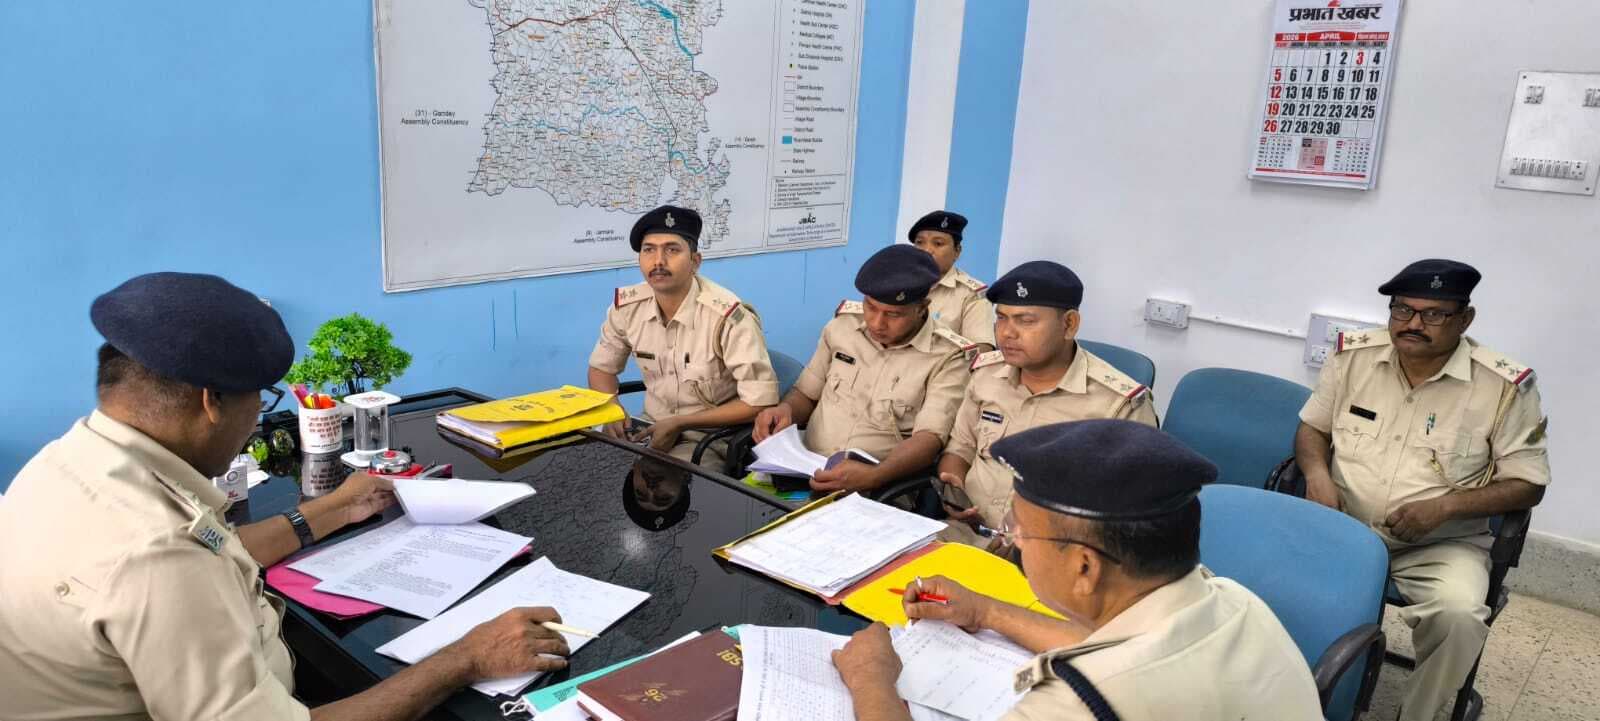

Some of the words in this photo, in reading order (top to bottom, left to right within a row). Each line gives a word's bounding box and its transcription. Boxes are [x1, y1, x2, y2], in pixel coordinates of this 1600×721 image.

[1289, 7, 1333, 21] प्रभात
[1337, 6, 1382, 20] खबर
[1282, 33, 1300, 41] 2026
[1325, 52, 1331, 65] 1
[1340, 52, 1348, 65] 2
[1356, 52, 1364, 65] 3
[1373, 52, 1381, 65] 4
[1274, 69, 1282, 82] 5
[1289, 69, 1297, 82] 6
[1306, 69, 1313, 82] 7
[1321, 69, 1329, 82] 8
[1337, 69, 1345, 82] 9
[1352, 69, 1364, 82] 10
[1368, 70, 1380, 83] 11
[1270, 86, 1282, 99] 12
[1285, 86, 1297, 99] 13
[1301, 86, 1313, 99] 14
[1317, 87, 1329, 100] 15
[1333, 87, 1345, 100] 16
[1350, 87, 1361, 100] 17
[1365, 87, 1377, 101] 18
[1267, 102, 1280, 116] 19
[1282, 103, 1296, 116] 20
[1297, 103, 1311, 116] 21
[1313, 104, 1326, 117] 22
[1328, 104, 1343, 118] 23
[1344, 105, 1359, 118] 24
[1361, 105, 1375, 119] 25
[1264, 119, 1278, 133] 26
[1280, 120, 1293, 133] 27
[1295, 120, 1309, 134] 28
[1310, 121, 1325, 135] 29
[1326, 121, 1340, 135] 30
